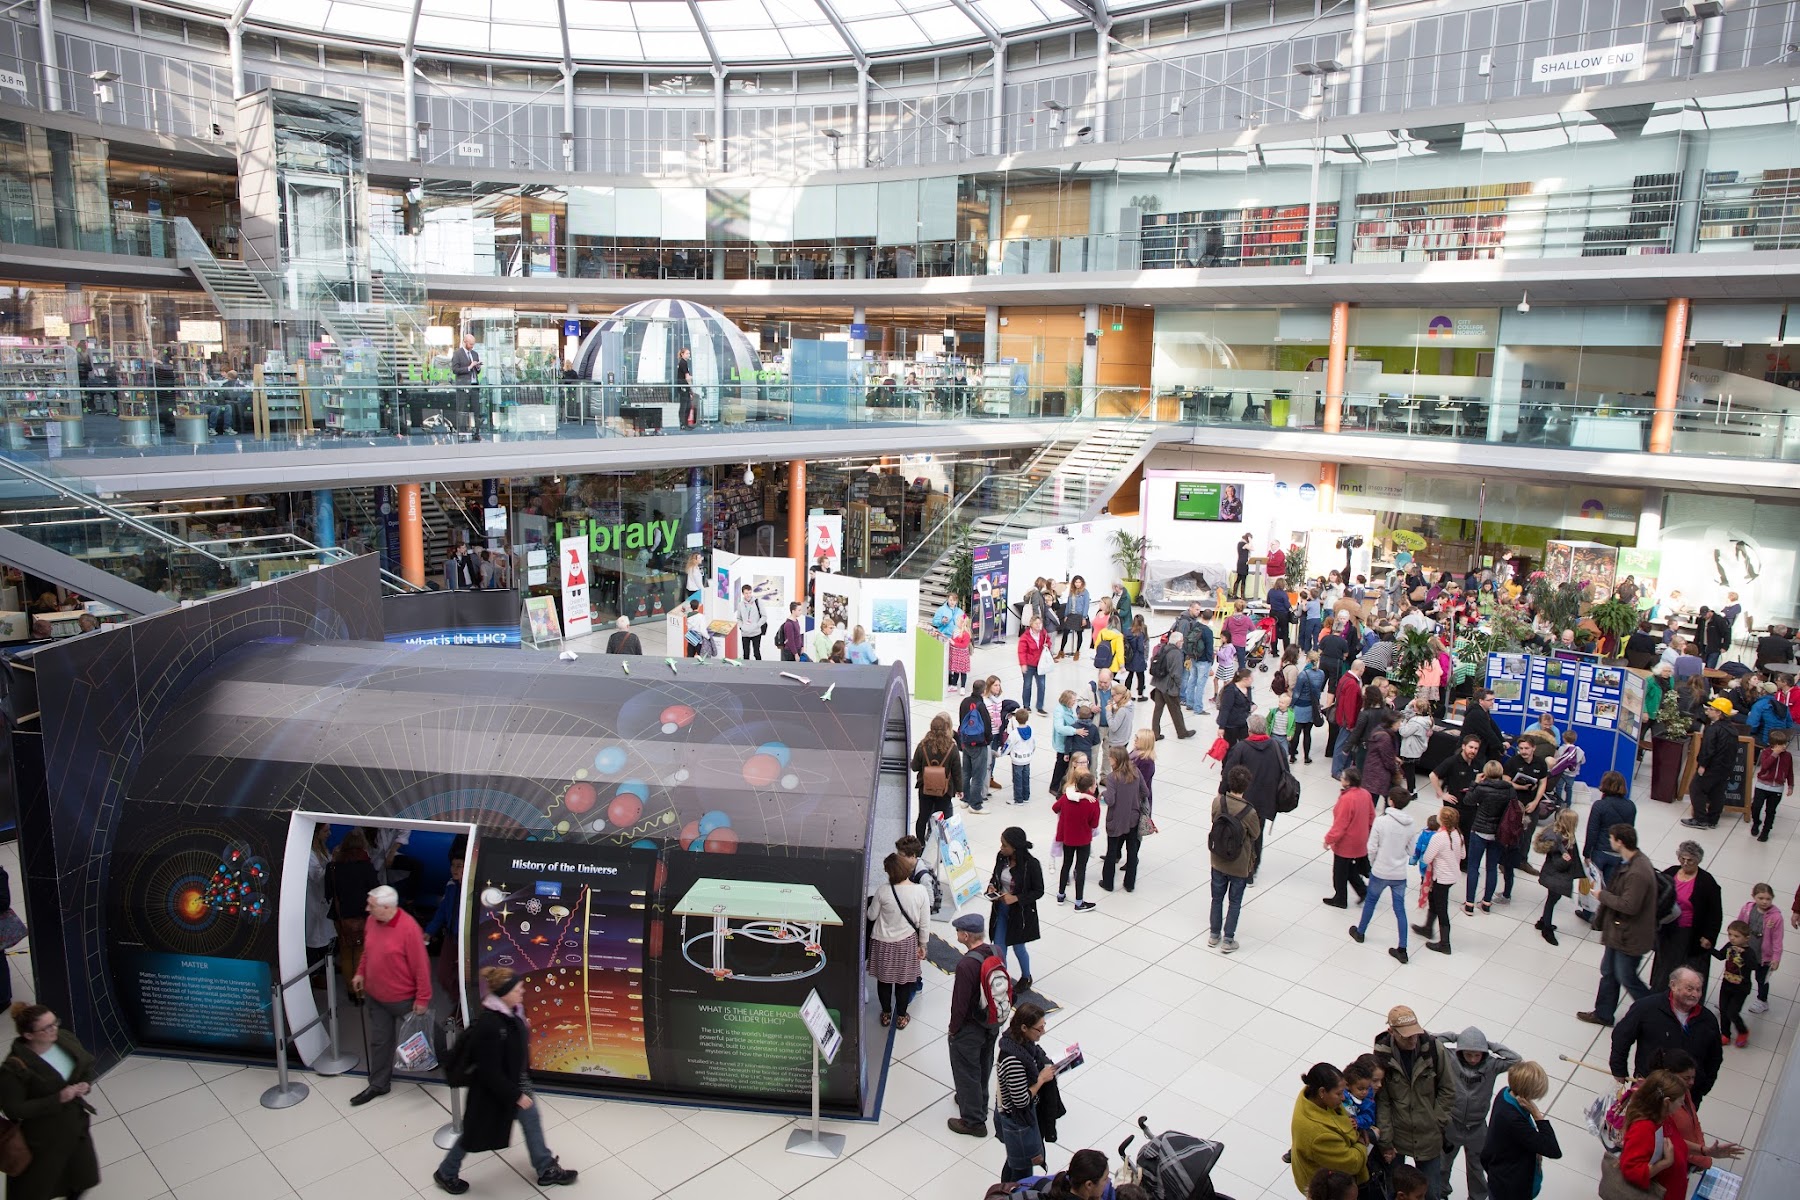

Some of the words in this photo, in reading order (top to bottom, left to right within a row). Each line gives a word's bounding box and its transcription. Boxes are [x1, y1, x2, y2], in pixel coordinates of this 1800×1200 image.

[1540, 57, 1602, 73] SHALLOW
[1607, 53, 1634, 64] END
[1, 74, 14, 84] 3.8
[730, 367, 782, 384] Library
[409, 491, 417, 522] Library
[1395, 531, 1424, 546] Welcome
[405, 636, 438, 646] What
[441, 634, 450, 645] is
[453, 633, 473, 645] the
[477, 633, 506, 644] LHC?
[511, 859, 547, 872] History
[548, 861, 559, 872] of
[560, 863, 575, 872] the
[578, 864, 618, 875] Universe
[181, 960, 208, 969] MATTER
[187, 976, 213, 984] everything
[698, 1004, 723, 1013] WHAT
[732, 1007, 747, 1015] THE
[749, 1009, 774, 1017] LARGE
[776, 1011, 802, 1019] HADRO
[723, 1014, 760, 1023] COLLIDER
[762, 1017, 786, 1025] (LHC)?
[593, 1064, 612, 1074] Bang
